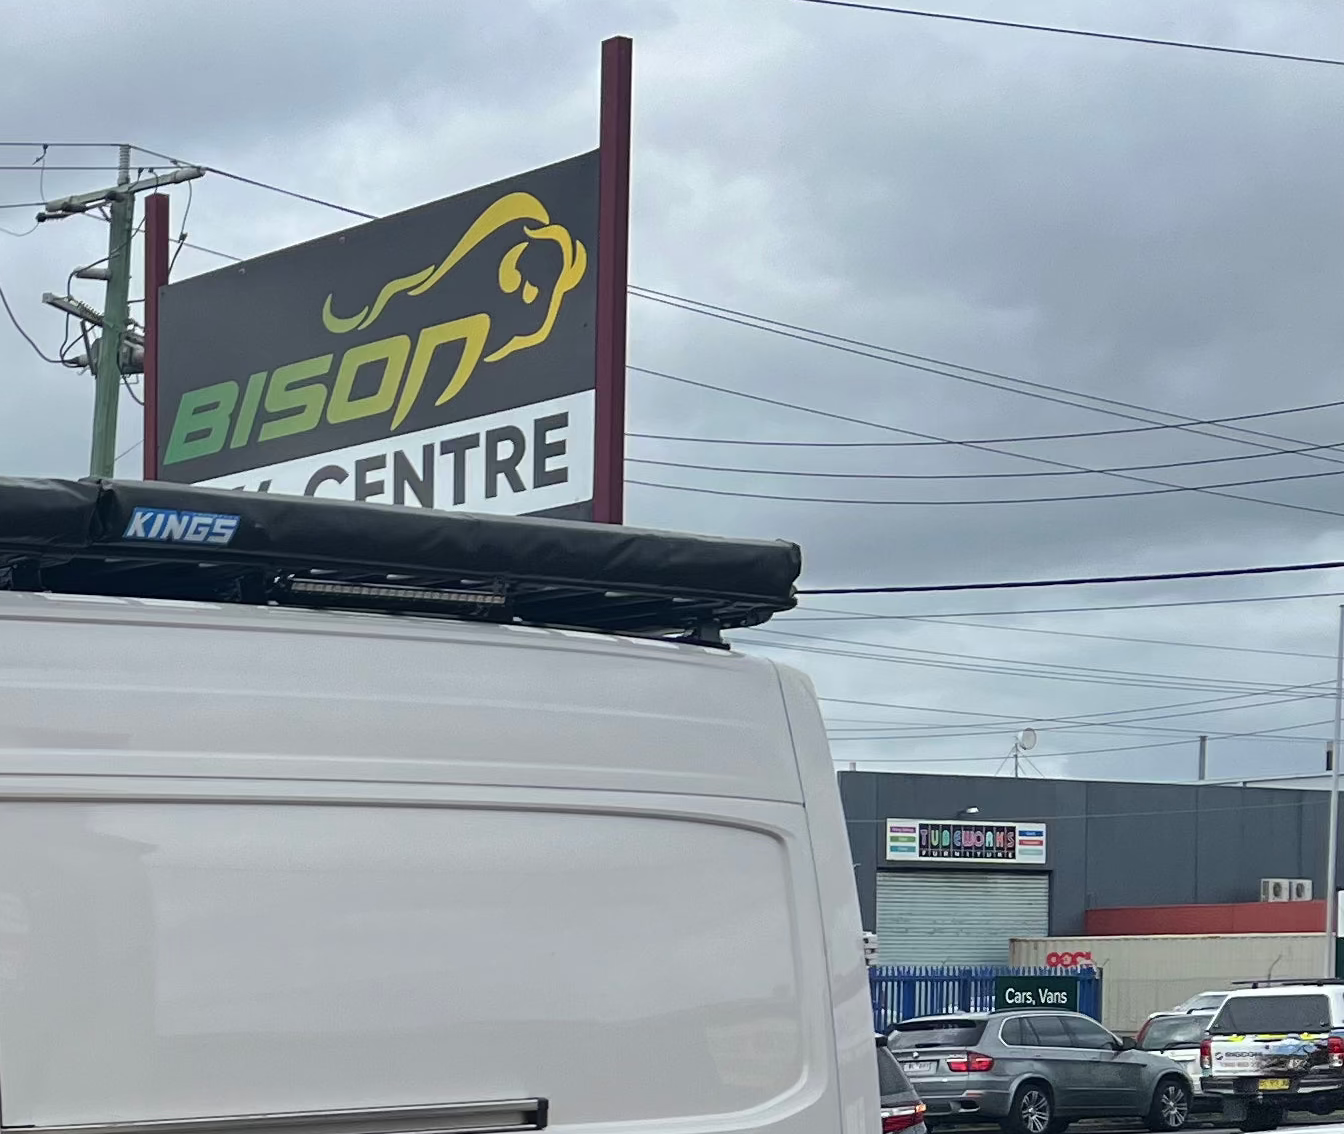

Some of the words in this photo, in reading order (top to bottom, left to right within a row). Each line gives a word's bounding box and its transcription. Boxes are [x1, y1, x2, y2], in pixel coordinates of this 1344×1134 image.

[125, 511, 238, 543] KINGS
[1005, 987, 1036, 1006] Cars,
[1038, 987, 1068, 1004] Vans
